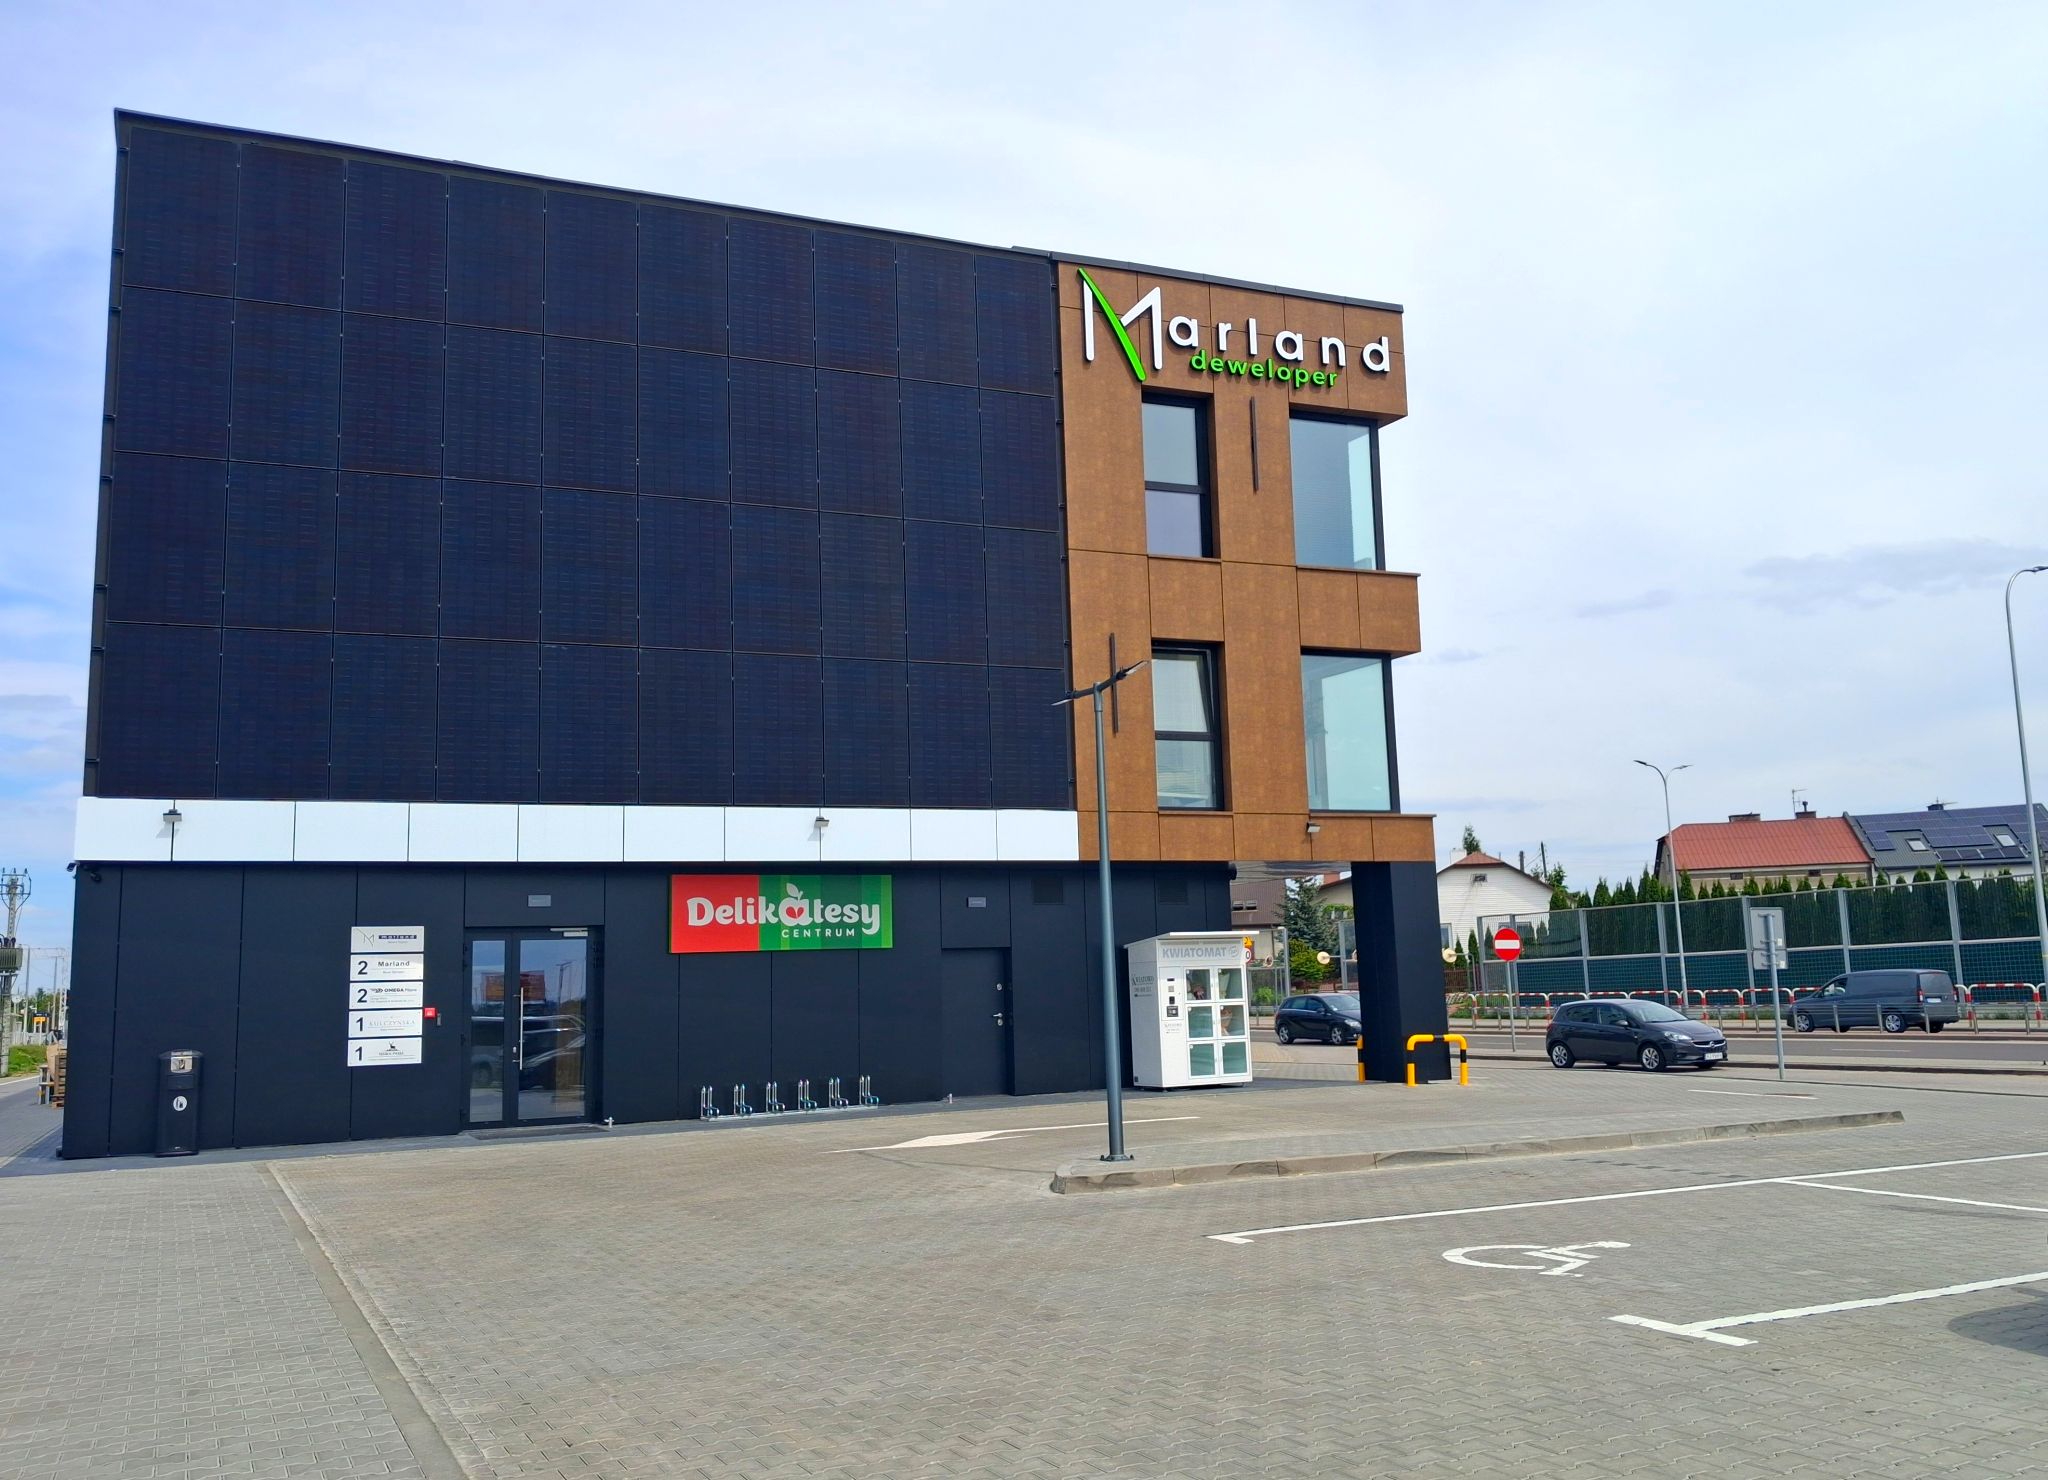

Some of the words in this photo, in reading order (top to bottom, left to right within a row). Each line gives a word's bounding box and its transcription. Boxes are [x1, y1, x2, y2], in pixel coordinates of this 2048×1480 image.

[1078, 267, 1391, 382] Marland
[1190, 349, 1338, 389] deweloper
[686, 893, 881, 935] Delikatesy
[781, 927, 856, 938] CENTRUM
[1162, 947, 1227, 959] KWIATOMAT
[357, 960, 369, 976] 2
[357, 988, 368, 1004] 2
[355, 1016, 364, 1032] 1
[354, 1046, 363, 1062] 1
